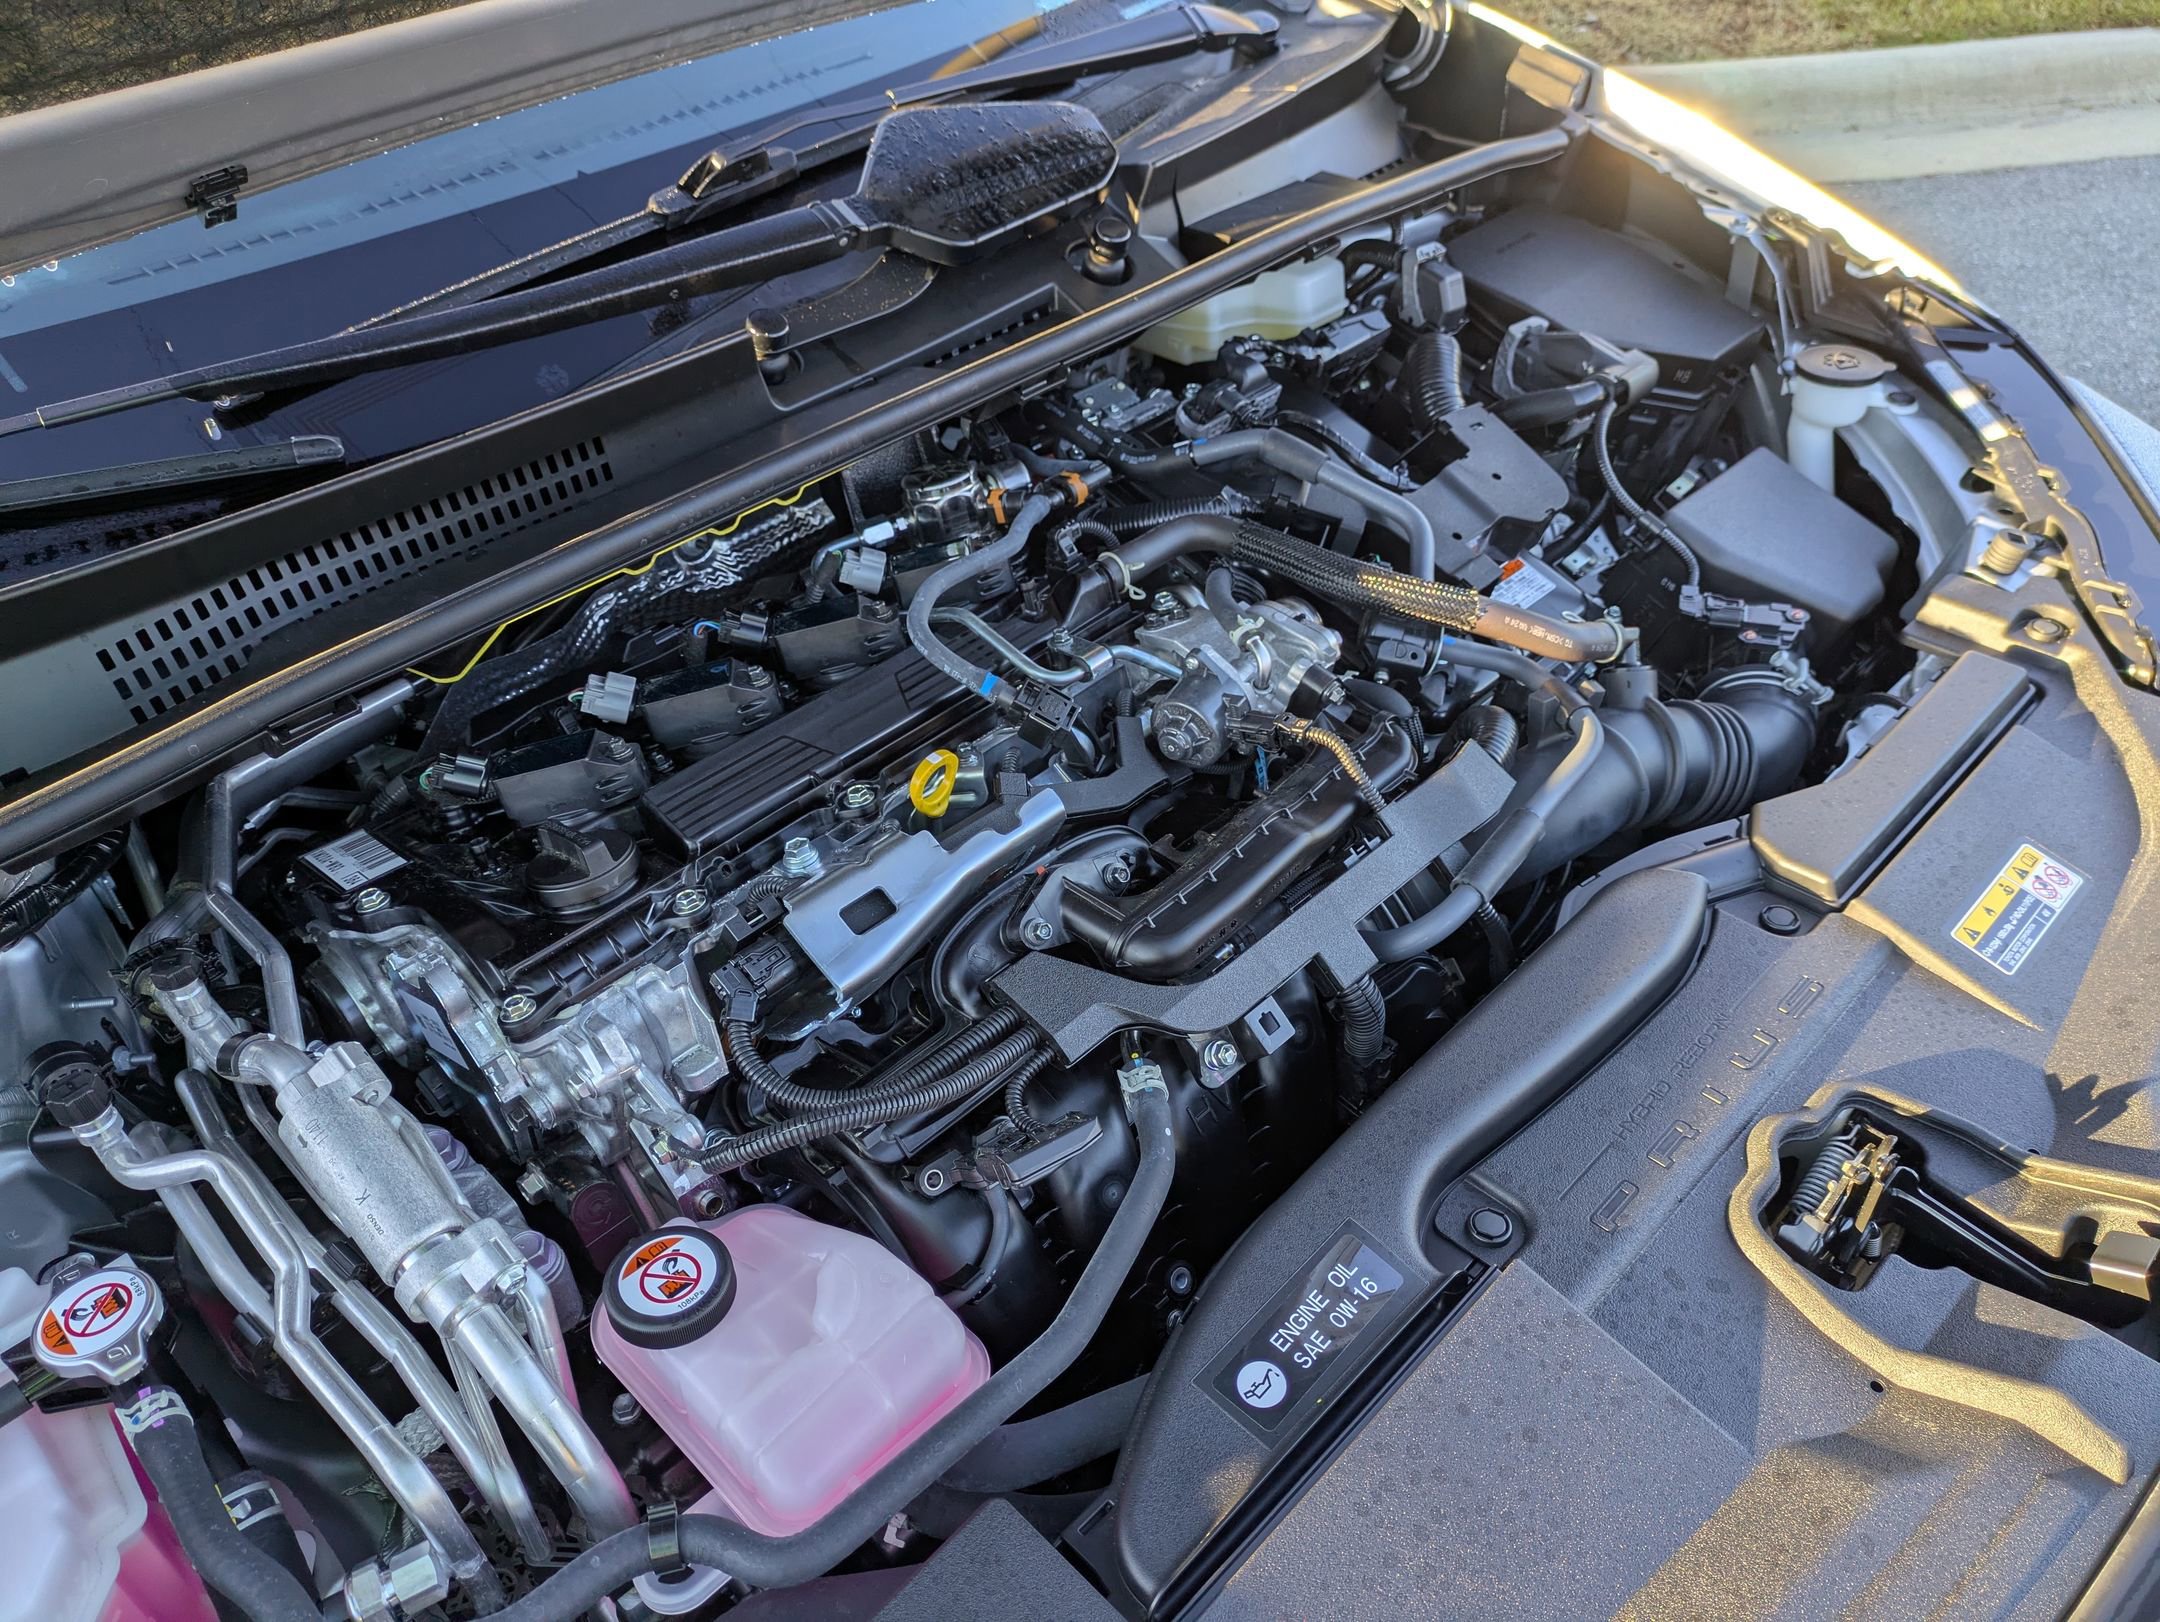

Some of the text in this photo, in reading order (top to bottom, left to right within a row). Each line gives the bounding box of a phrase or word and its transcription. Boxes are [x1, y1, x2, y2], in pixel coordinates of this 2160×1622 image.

[1612, 1012, 1733, 1142] HYBRID REBORN
[367, 1213, 384, 1236] DENSO
[677, 1289, 705, 1310] 108kPa
[1269, 1263, 1359, 1353] ENGINE OIL
[1293, 1277, 1378, 1369] SAE 0W-16
